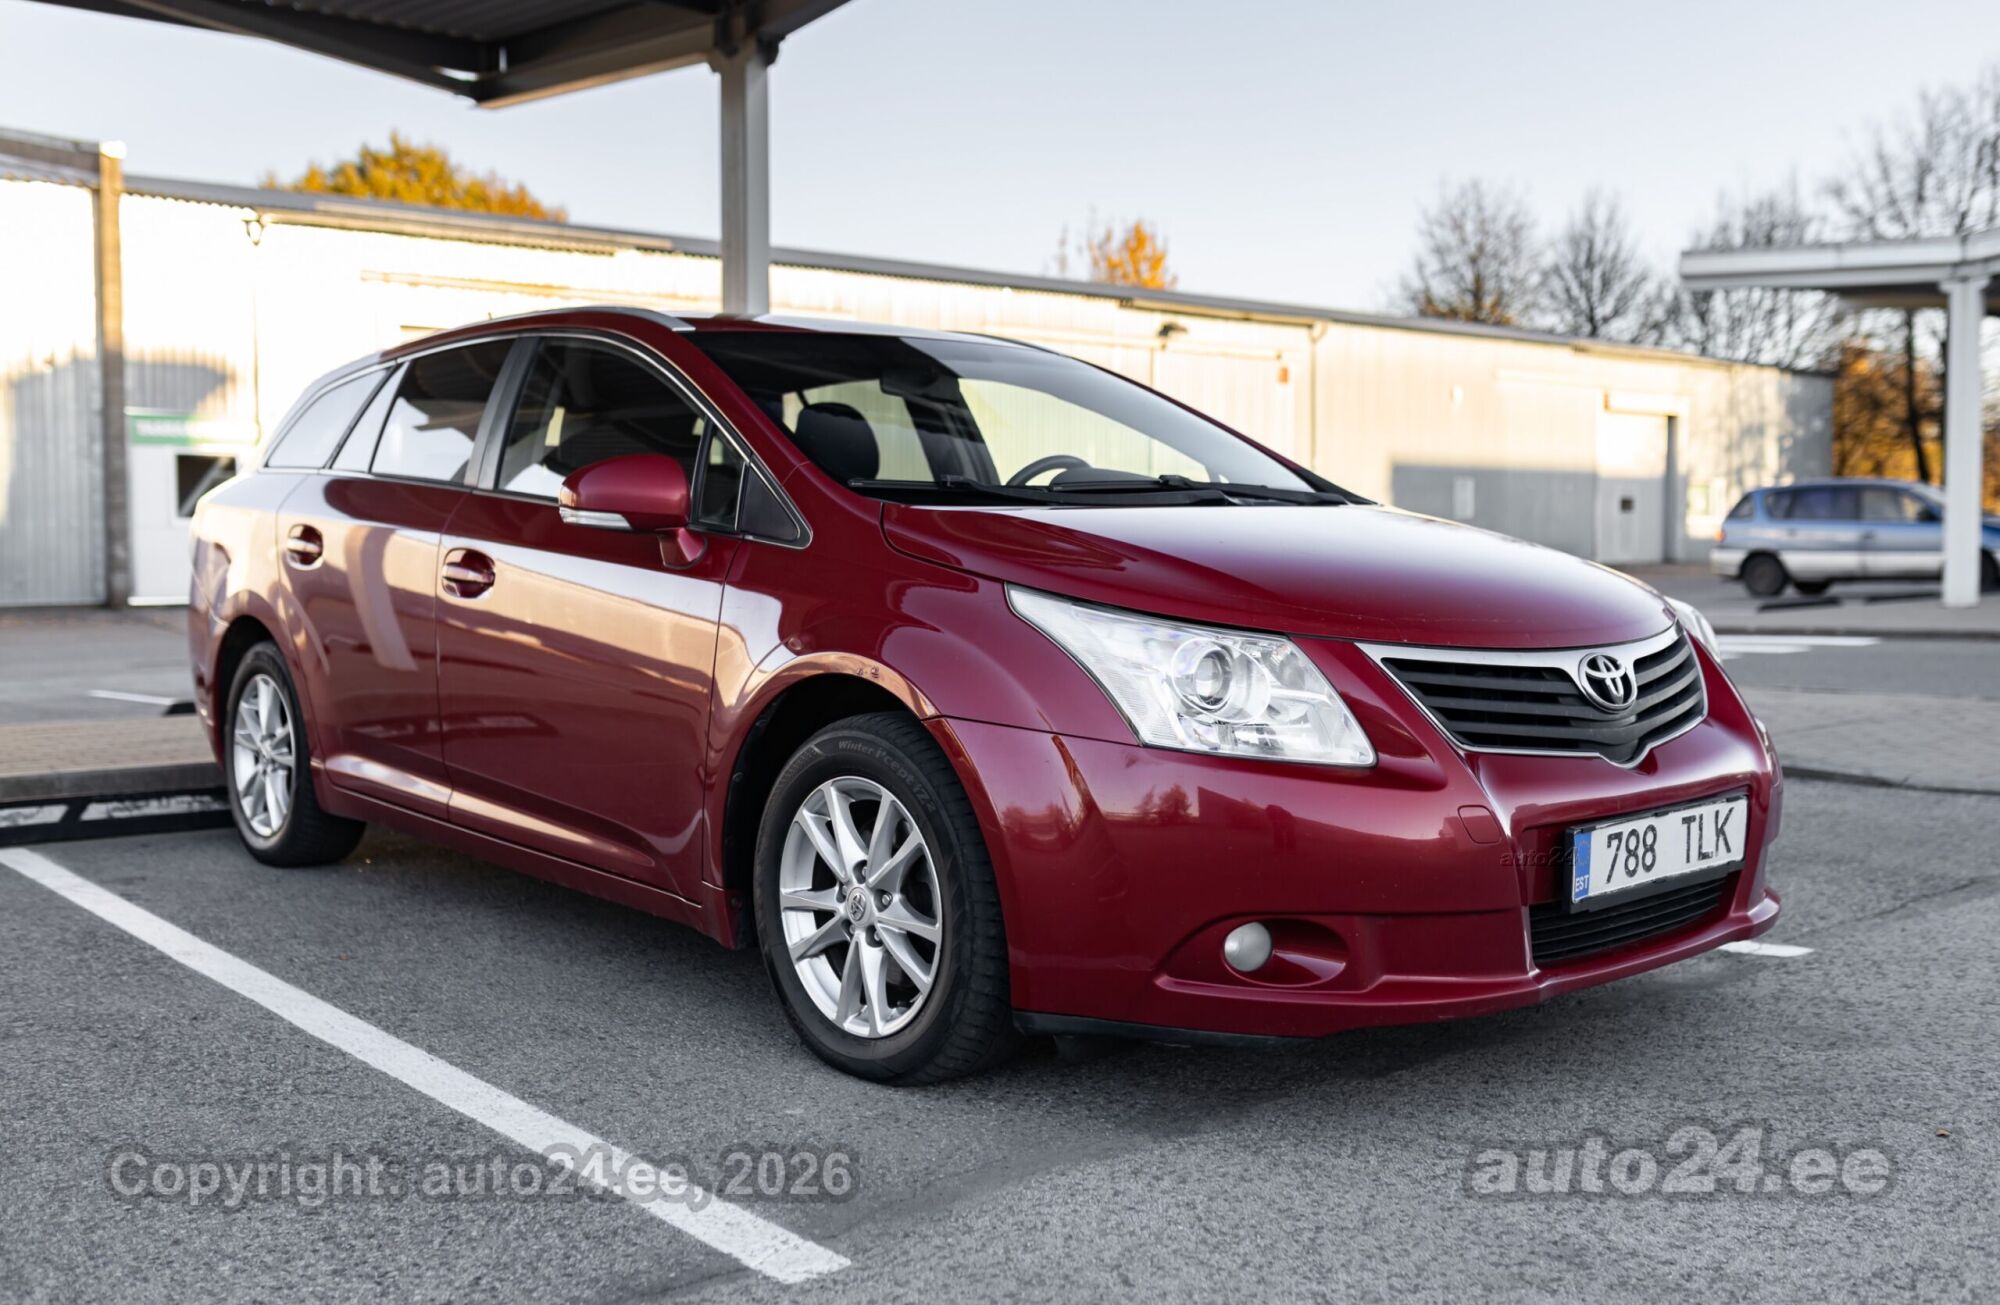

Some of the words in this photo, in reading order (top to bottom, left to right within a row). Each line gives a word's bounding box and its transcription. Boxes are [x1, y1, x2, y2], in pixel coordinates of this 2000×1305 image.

[1605, 825, 1657, 884] 788
[1682, 807, 1735, 863] TLK
[1575, 874, 1589, 892] EST
